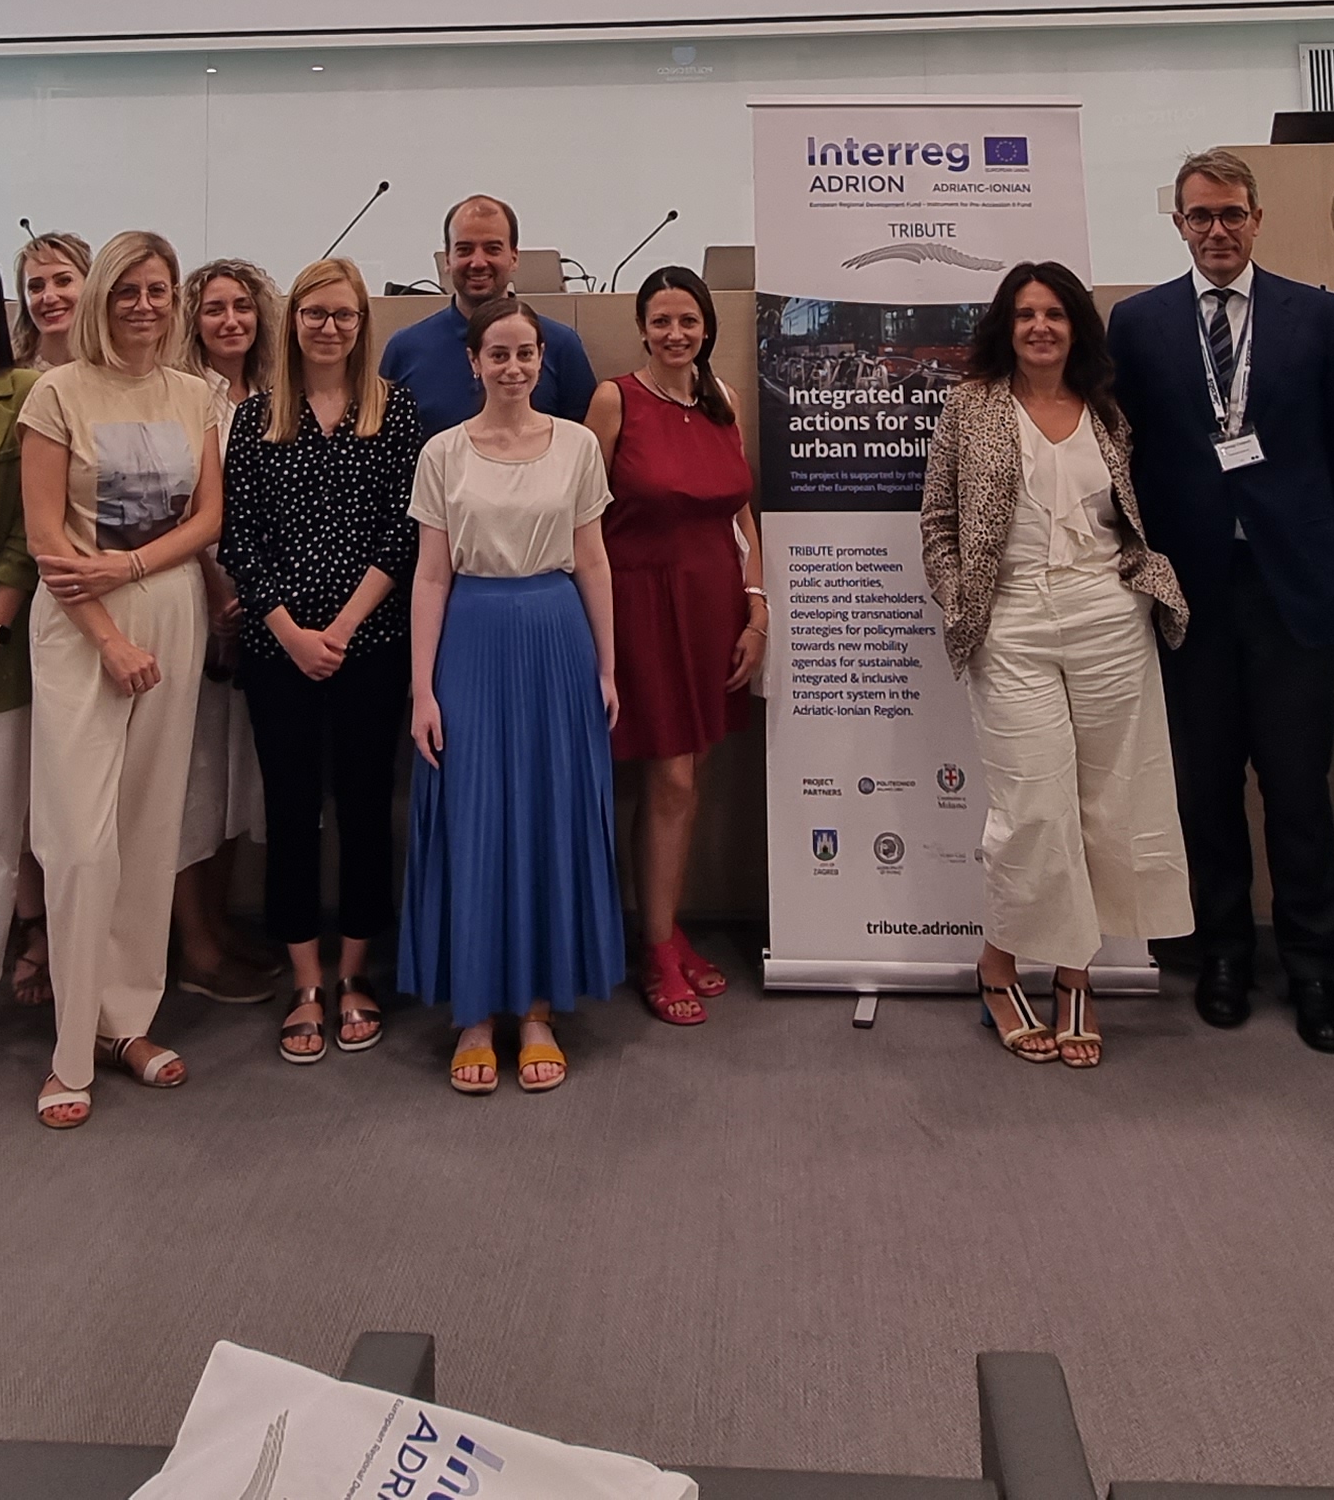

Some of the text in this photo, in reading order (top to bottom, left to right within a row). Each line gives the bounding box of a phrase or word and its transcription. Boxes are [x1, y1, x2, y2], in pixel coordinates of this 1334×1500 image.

[807, 137, 970, 172] Interreg
[809, 175, 905, 193] ADRION
[932, 183, 1031, 193] ADRIATIC-IONIAN
[888, 223, 956, 238] TRIBUTE
[789, 385, 904, 409] Integrated
[789, 411, 870, 431] actions
[875, 411, 908, 431] for
[790, 438, 857, 458] urban
[790, 470, 922, 481] This project is supported by the
[790, 484, 816, 492] under
[835, 483, 875, 493] European
[877, 483, 913, 493] Regional
[788, 546, 888, 558] TRIBUTE promotes
[789, 561, 903, 574] cooperation between
[789, 577, 884, 589] public authorities,
[790, 593, 927, 605] citizens and stakeholders,
[790, 609, 923, 621] developing transnational
[791, 625, 936, 637] strategies for policymakers
[791, 640, 909, 654] towards new mobility
[791, 656, 923, 669] agendas for sustainable,
[792, 673, 909, 685] integrated & inclusive
[792, 689, 921, 701] transport system in the
[792, 705, 914, 718] Adriatic-Ionian Region.
[803, 778, 834, 786] PROJECT
[866, 920, 984, 936] tribute.adrionin
[376, 1398, 404, 1443] European
[356, 1443, 381, 1482] Regional
